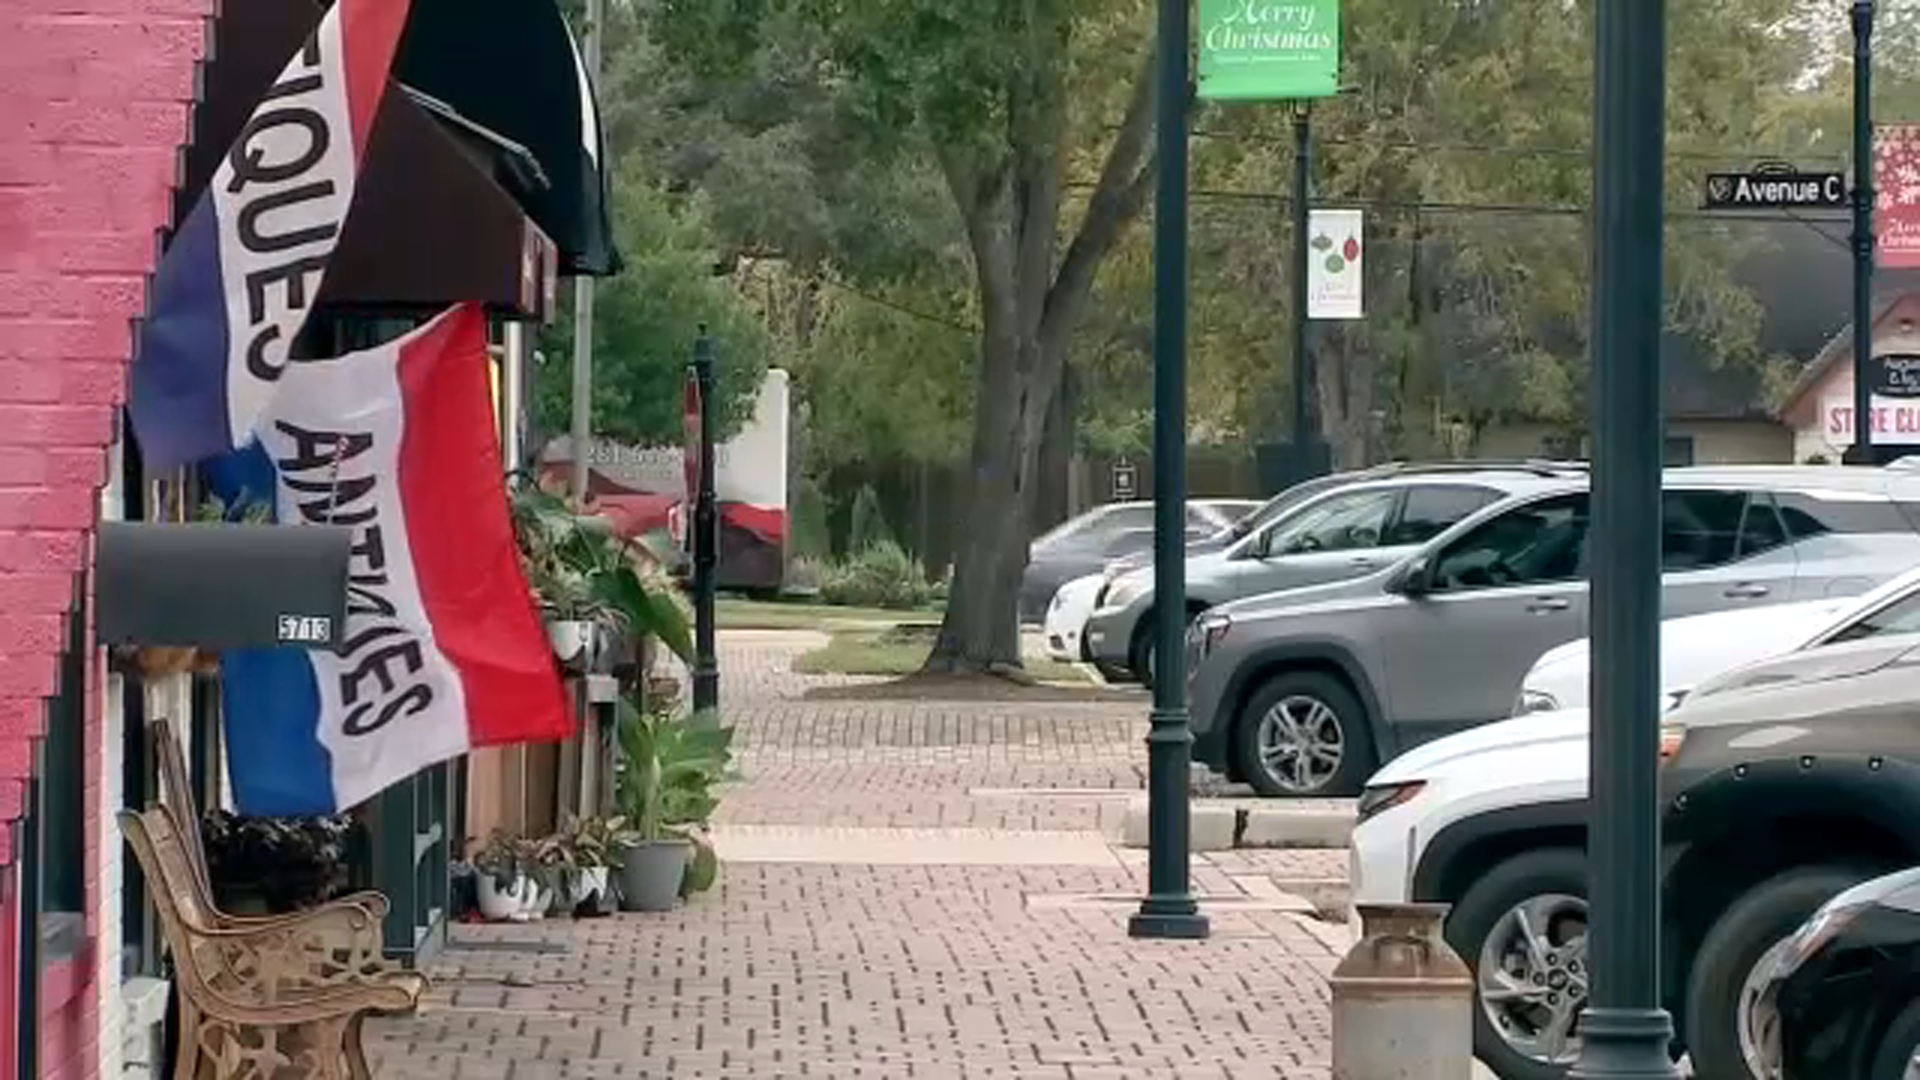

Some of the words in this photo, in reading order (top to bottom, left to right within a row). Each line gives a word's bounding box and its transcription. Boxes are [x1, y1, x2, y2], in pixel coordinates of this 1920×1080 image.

[1222, 0, 1315, 31] Merry
[1205, 23, 1332, 51] Christmas
[1735, 176, 1819, 201] Avenue
[1824, 176, 1840, 201] C
[1830, 407, 1888, 433] STRE
[280, 615, 329, 641] 5713
